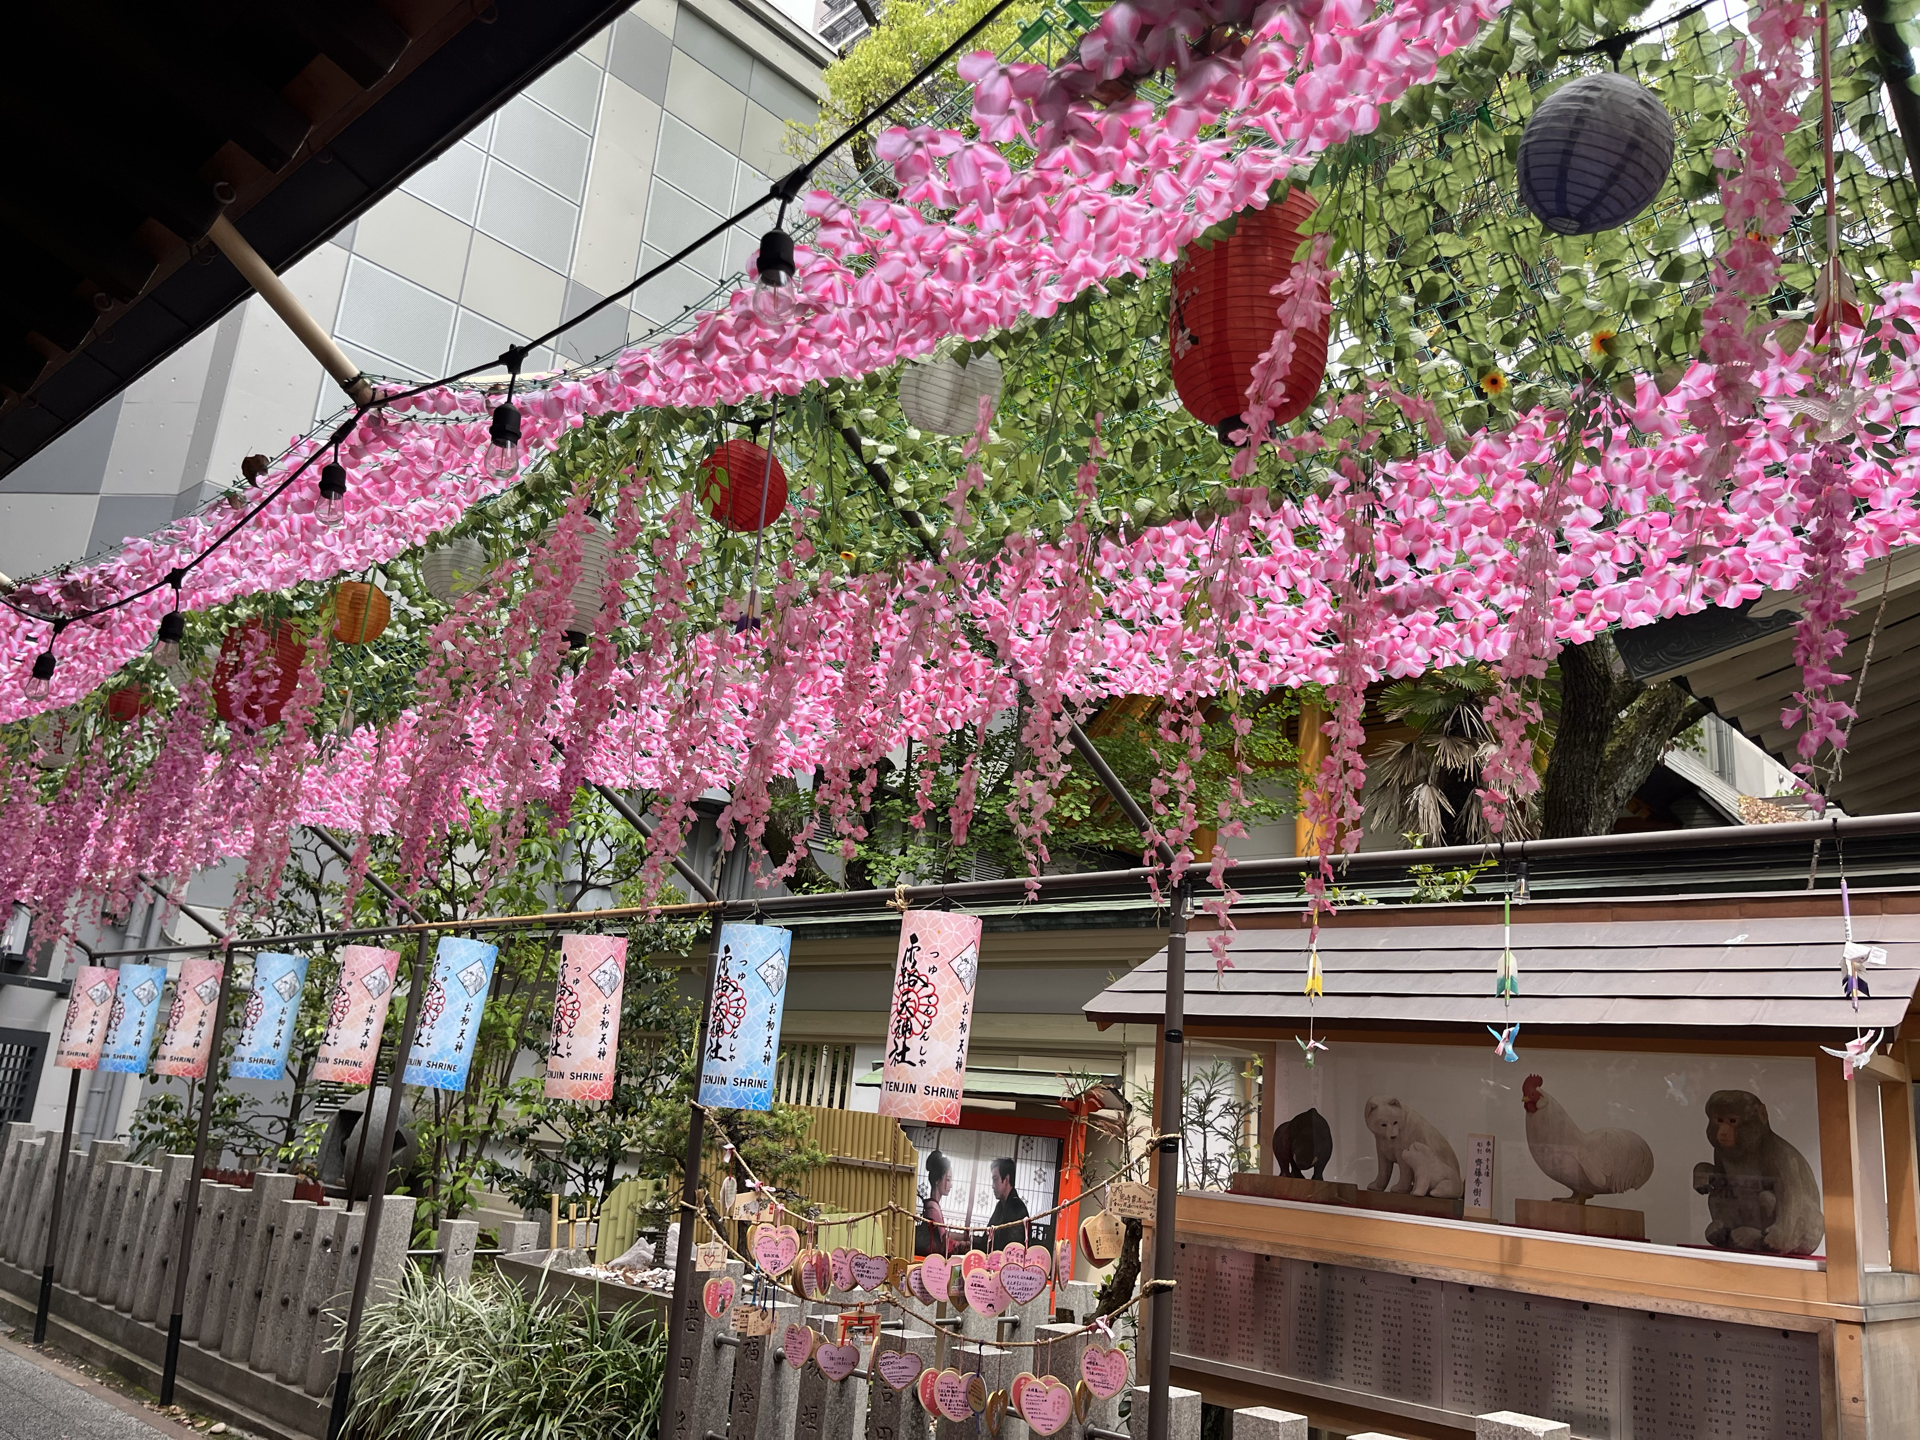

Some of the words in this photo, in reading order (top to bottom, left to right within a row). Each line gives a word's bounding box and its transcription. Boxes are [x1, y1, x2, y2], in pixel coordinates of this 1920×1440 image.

[86, 1010, 100, 1045] お初天神
[134, 1010, 148, 1048] お初天神
[193, 1009, 208, 1049] お初天神
[274, 1007, 288, 1050] お初天神
[360, 1004, 377, 1051] お初天神
[454, 1003, 472, 1054] お初天神
[598, 1004, 610, 1061] お初天神
[763, 1003, 777, 1066] お初天神
[956, 1002, 969, 1074] お初天神
[170, 1056, 195, 1064] SHRINE
[248, 1057, 276, 1065] SHRINE
[333, 1058, 363, 1068] SHRINE
[426, 1061, 458, 1072] SHRINE
[570, 1072, 603, 1081] SHRINE
[703, 1074, 726, 1086] TENJIN
[733, 1077, 767, 1088] SHRINE
[885, 1080, 916, 1094] TENJIN
[924, 1086, 959, 1100] SHRINE
